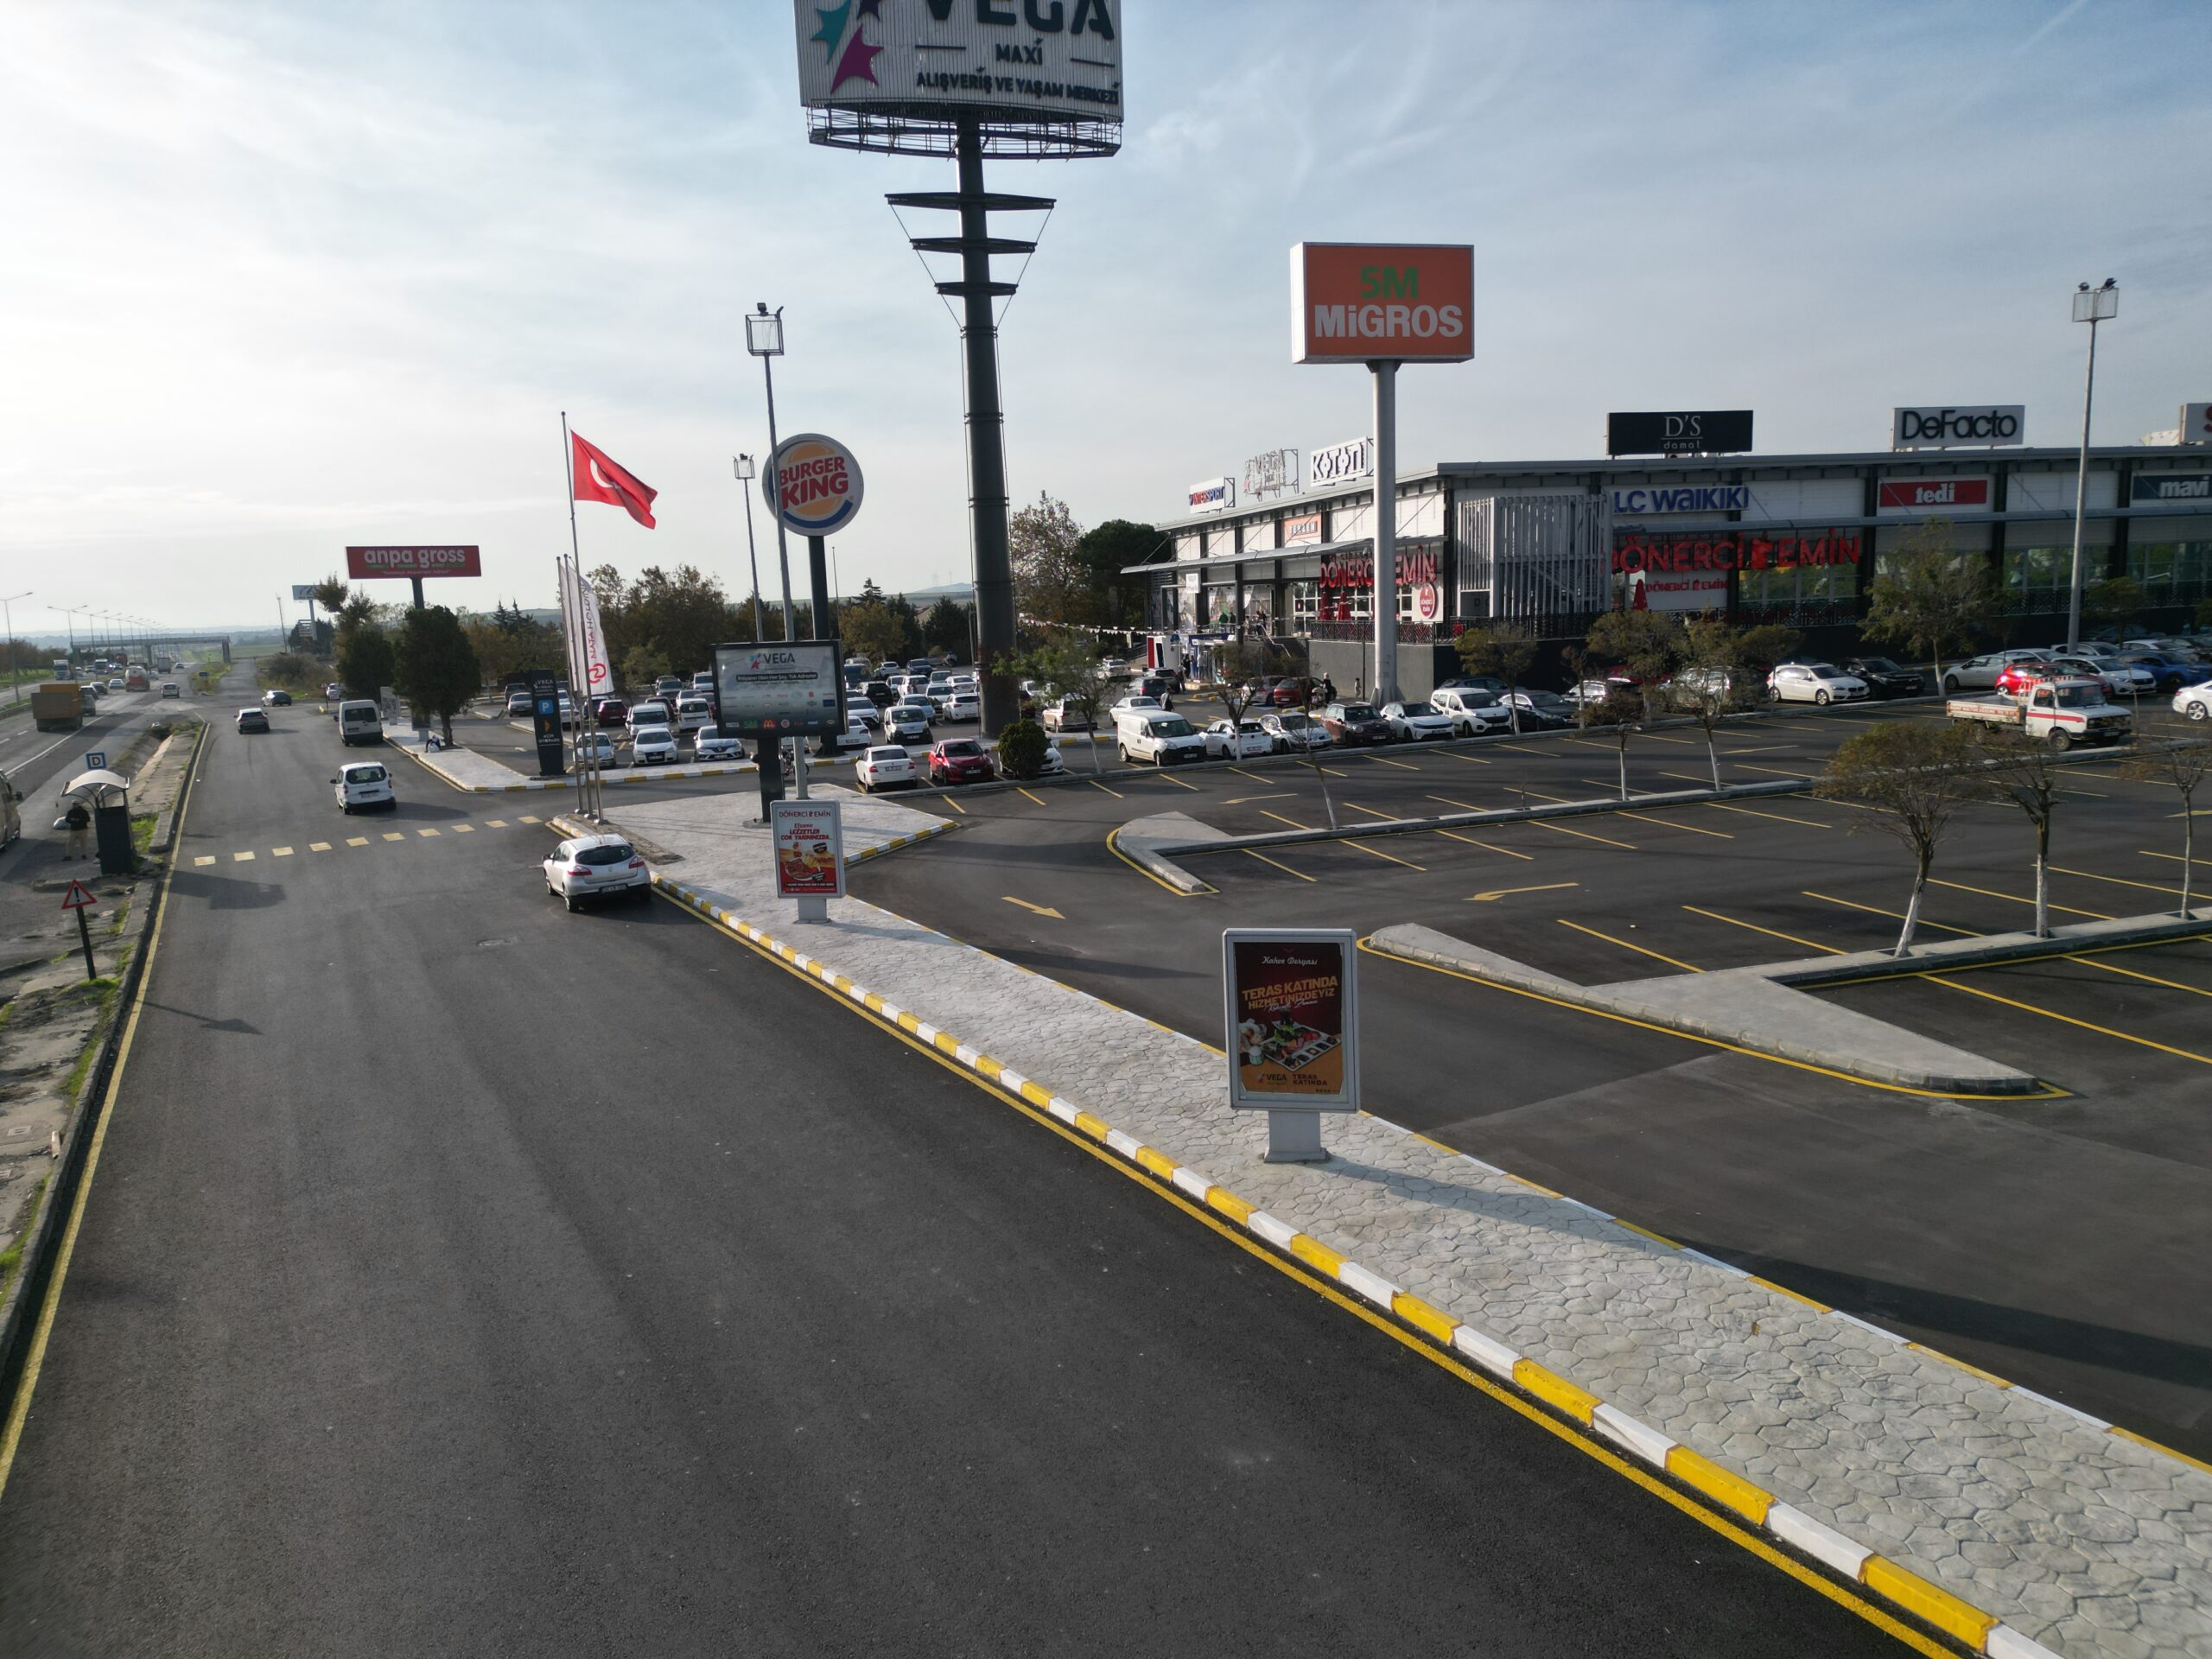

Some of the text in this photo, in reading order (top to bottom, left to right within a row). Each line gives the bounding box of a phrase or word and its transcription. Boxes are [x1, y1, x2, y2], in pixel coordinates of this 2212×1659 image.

[917, 67, 992, 93] ALIŞVERİŞ
[995, 76, 1014, 92] VE
[1016, 78, 1064, 99] YAŞAM
[1361, 266, 1418, 299] 5M
[1902, 410, 2018, 440] DeFacto
[779, 456, 845, 486] BURGER
[781, 472, 849, 510] KING
[2160, 475, 2209, 497] mavi
[1614, 490, 1646, 512] LC
[364, 549, 465, 569] anpa gross
[1778, 528, 1859, 567] EMİN
[1319, 554, 1376, 588] DÖNERC
[1646, 578, 1728, 593] DÖNERCİ EMİN
[763, 652, 795, 664] VEGA
[542, 702, 550, 712] P
[92, 756, 101, 766] D
[1242, 976, 1338, 1001] TERAS KATINDA
